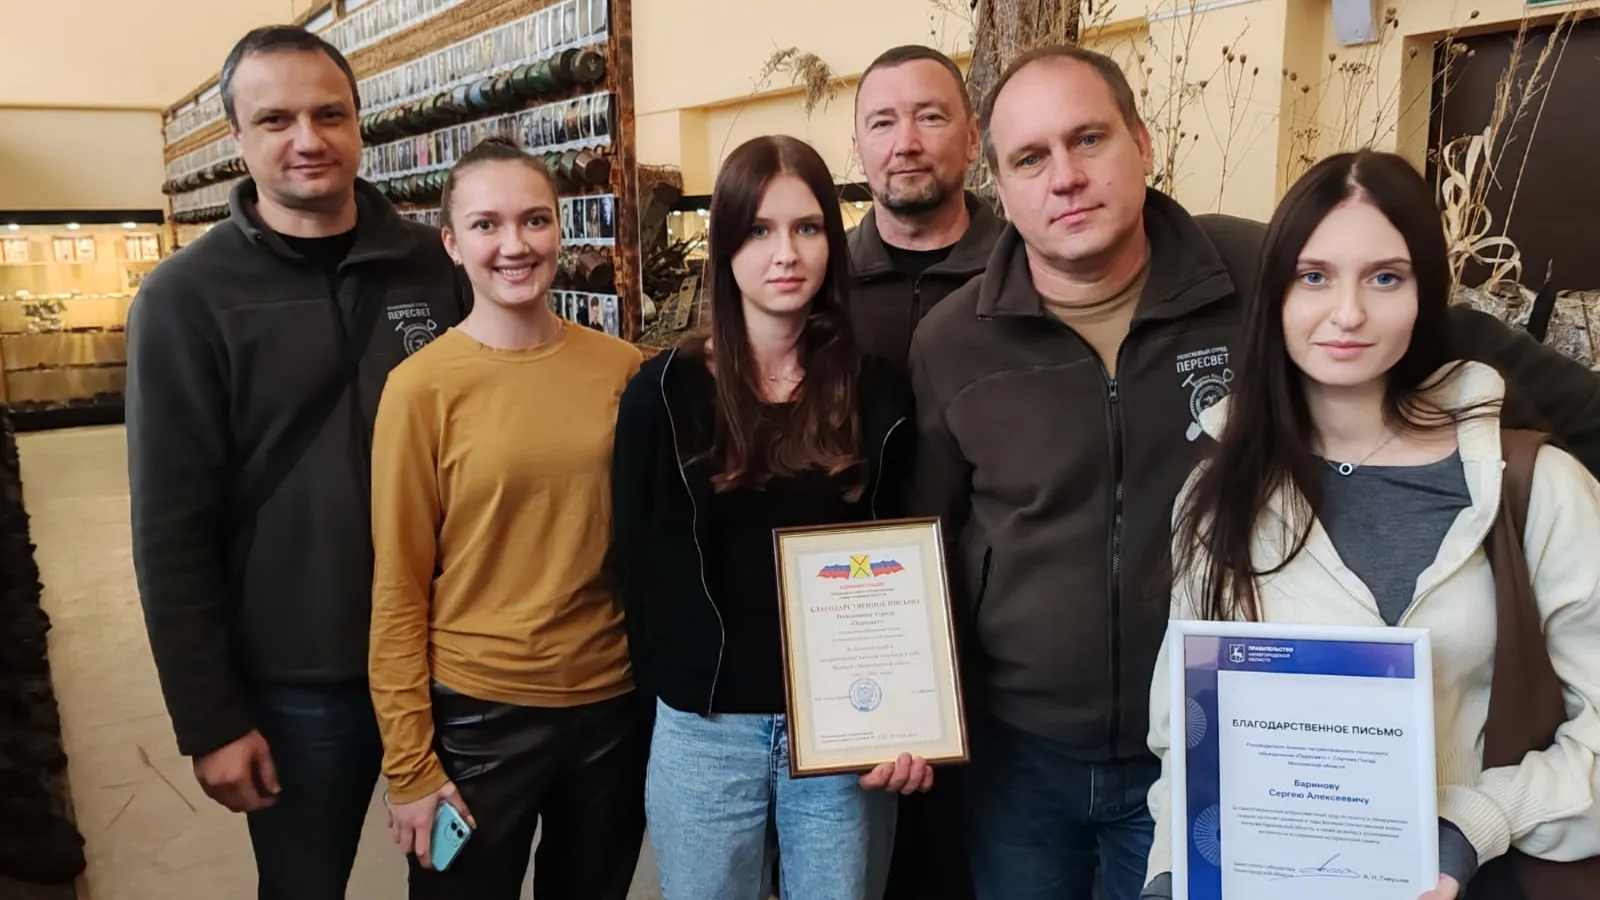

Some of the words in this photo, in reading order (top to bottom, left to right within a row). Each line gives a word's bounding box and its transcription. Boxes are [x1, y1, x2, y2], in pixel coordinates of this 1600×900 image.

[387, 308, 431, 320] ПЕРЕСВЕТ
[1176, 353, 1230, 373] ПЕРЕСВЕТ
[810, 600, 886, 613] БЛАГОДАРСТВЕННОЕ
[1232, 718, 1349, 734] БЛАГОДАРСТВЕННОЕ
[1352, 726, 1404, 737] ПИСЬМО
[1294, 779, 1340, 791] Баринову
[1268, 788, 1304, 799] Сергею
[1307, 792, 1370, 805] Алексеевичу
